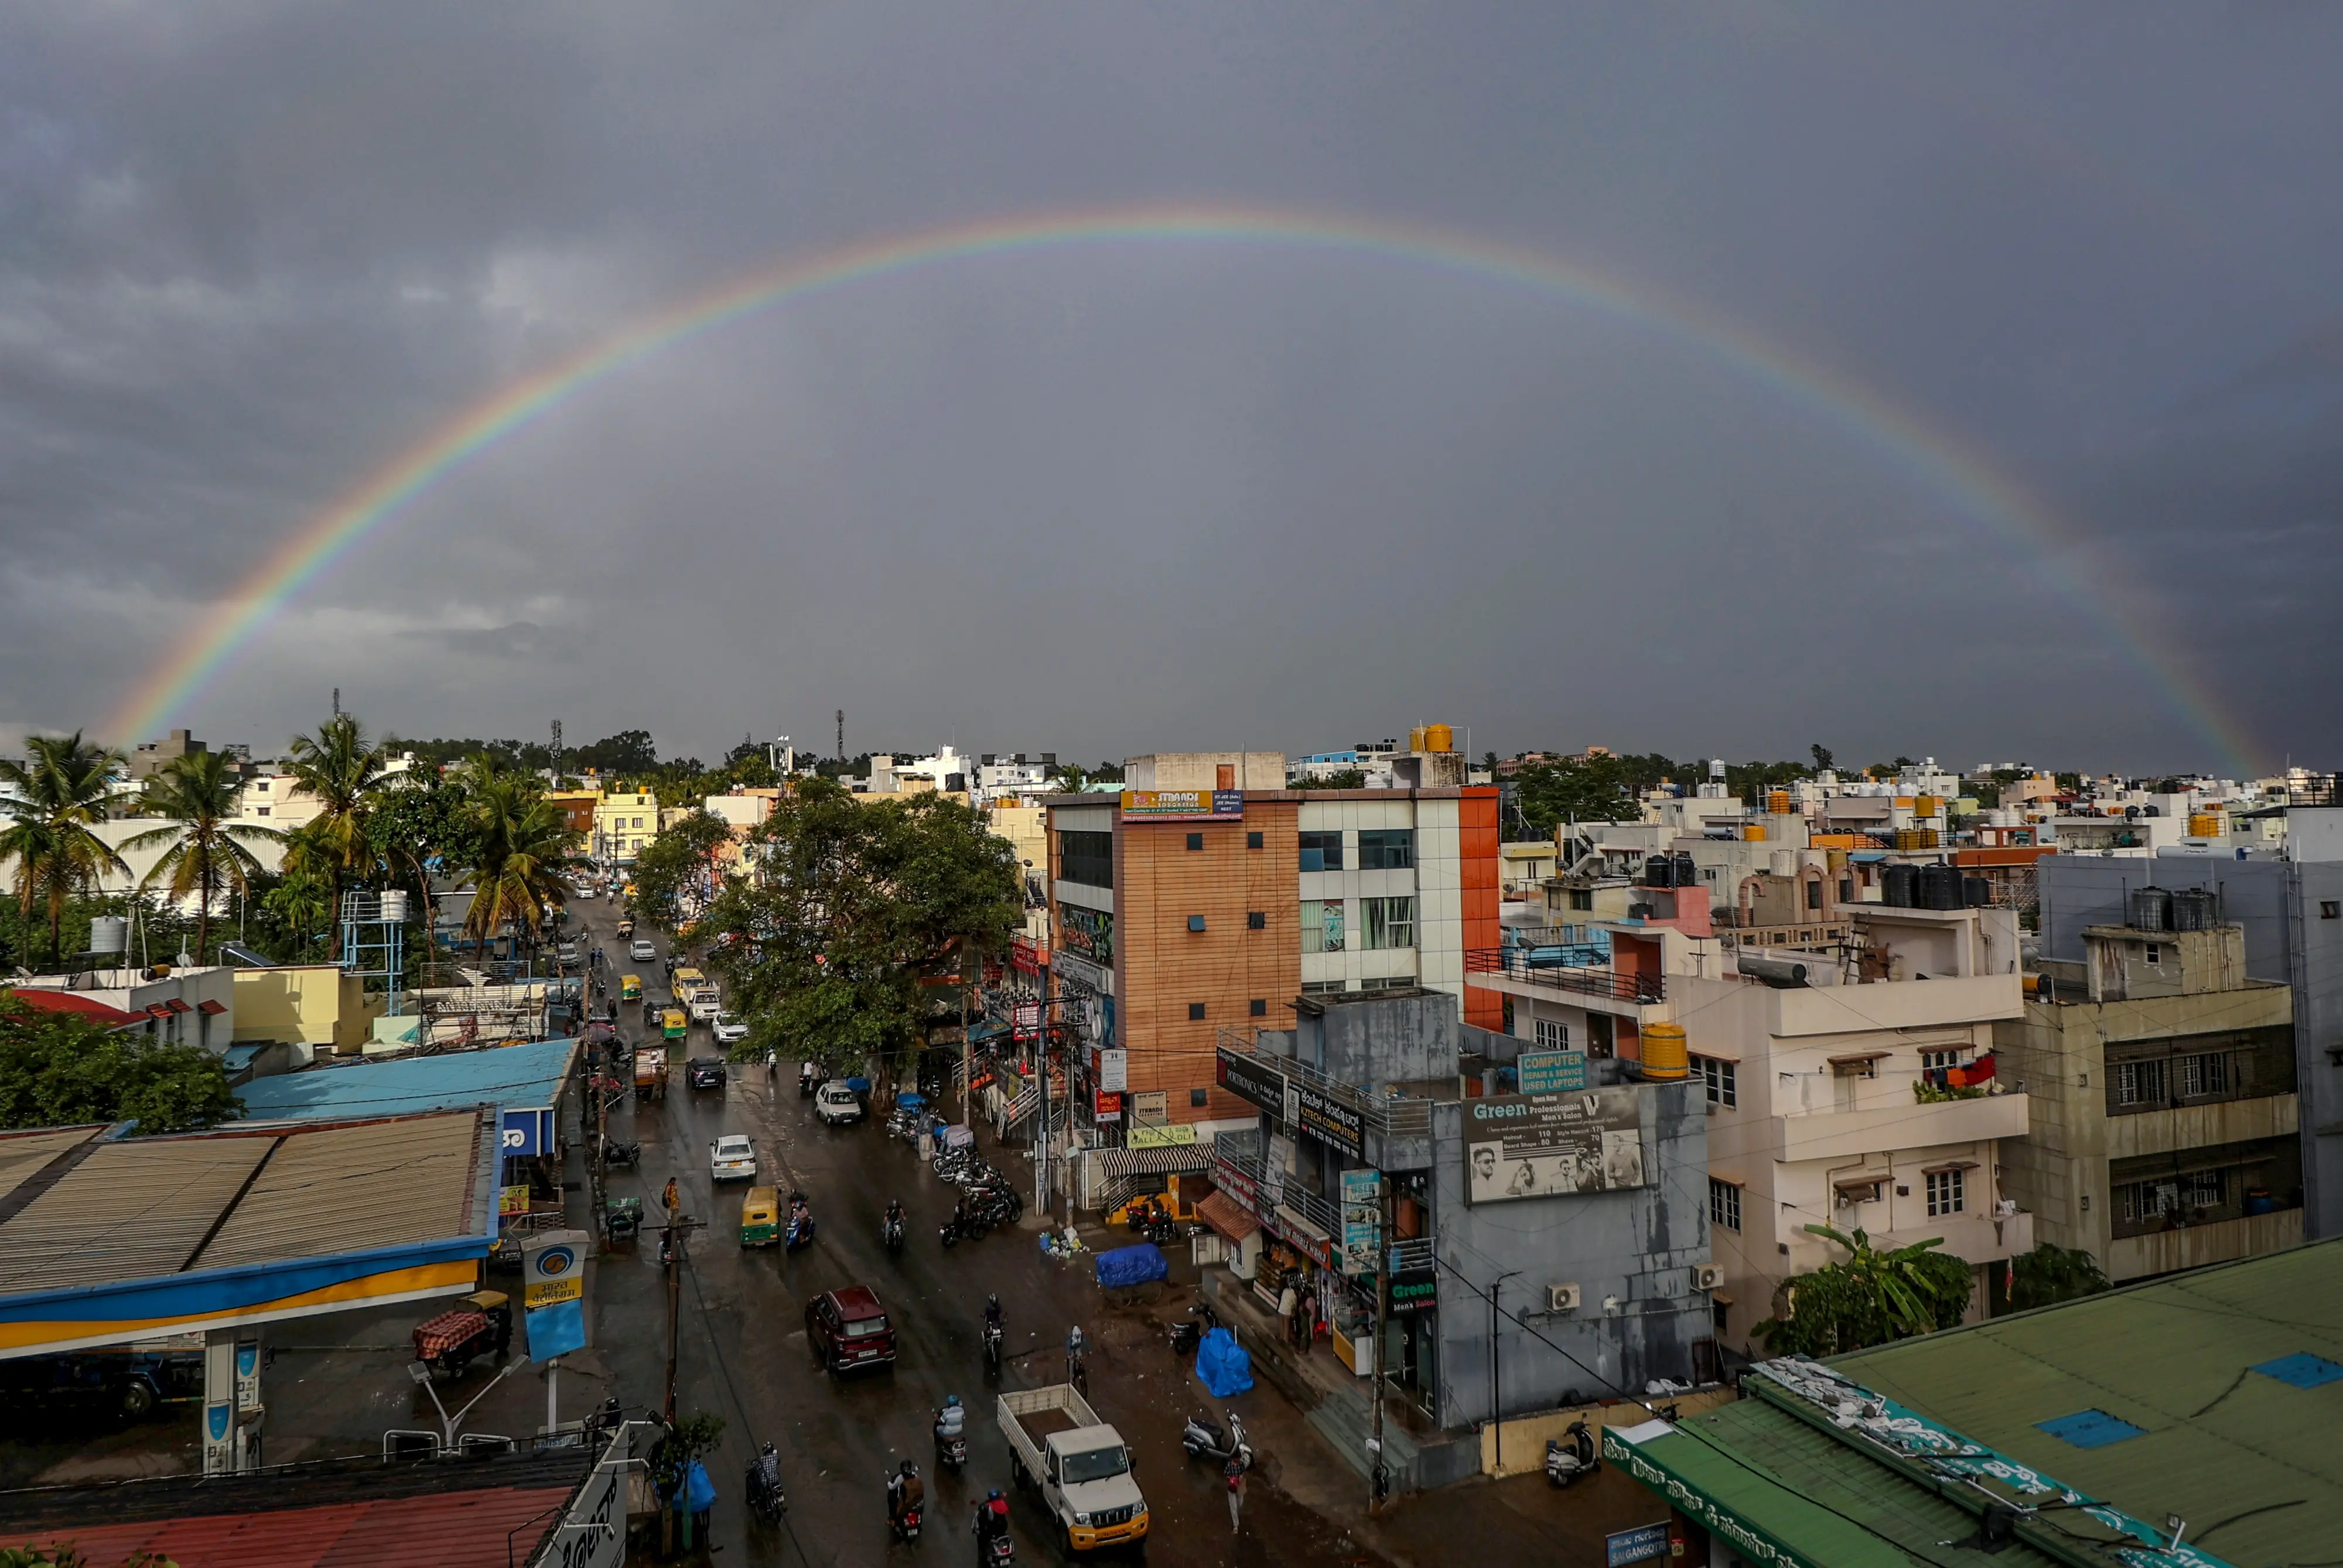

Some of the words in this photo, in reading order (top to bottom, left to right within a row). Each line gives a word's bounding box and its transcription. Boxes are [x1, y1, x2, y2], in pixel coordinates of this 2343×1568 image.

[1158, 792, 1198, 802] STRANDS
[1524, 1054, 1581, 1069] COMPUTER
[1524, 1071, 1547, 1080] REPAIR
[1555, 1067, 1582, 1077] SERVICE
[1227, 1069, 1257, 1094] PORTRONICS
[1524, 1081, 1546, 1090] USED
[1548, 1077, 1583, 1088] LAPTOPS
[1474, 1104, 1526, 1119] Green
[1529, 1103, 1581, 1113] Professionals
[1323, 1117, 1358, 1143] COMPUTERS
[1352, 1183, 1374, 1194] USED
[541, 1281, 568, 1292] भारत
[1392, 1283, 1435, 1298] Green
[1393, 1301, 1414, 1311] Men's
[1625, 1540, 1667, 1559] GANGOTRI
